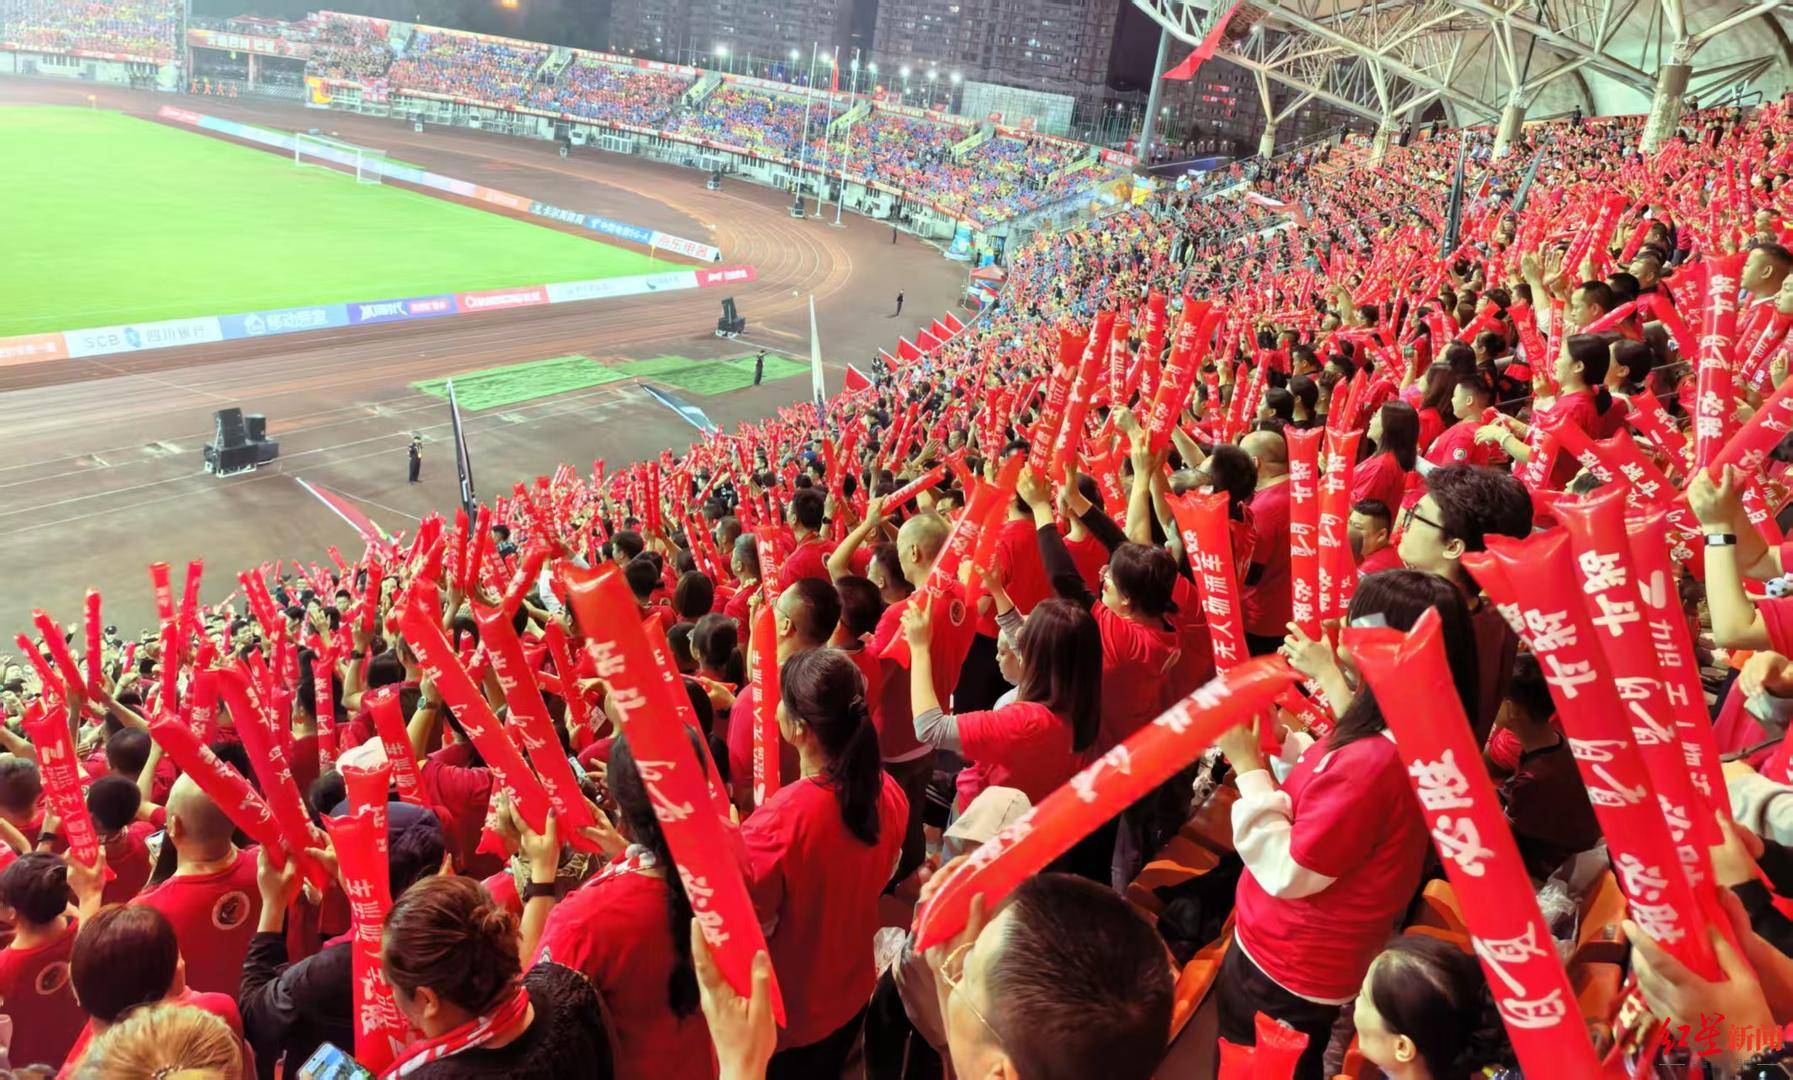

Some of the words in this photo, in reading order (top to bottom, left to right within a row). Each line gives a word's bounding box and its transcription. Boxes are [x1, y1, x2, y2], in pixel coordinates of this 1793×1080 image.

[1706, 274, 1735, 316] 战斗
[83, 334, 120, 350] SCB
[146, 325, 205, 342] 四川银行
[1700, 334, 1731, 371] 自贡
[1697, 390, 1725, 440] 必胜
[1290, 459, 1313, 504] 战斗
[1325, 452, 1347, 495] 战斗
[1290, 522, 1317, 557] 自贡
[1200, 550, 1237, 661] 无人物流车
[1293, 577, 1314, 623] 必胜
[1578, 549, 1640, 638] 战斗
[1614, 675, 1675, 746] 自贡
[1523, 608, 1598, 700] 战斗
[1567, 736, 1648, 809] 自贡
[1615, 851, 1686, 945] 必胜
[1409, 748, 1495, 878] 必胜
[1473, 921, 1567, 1029] 自贡
